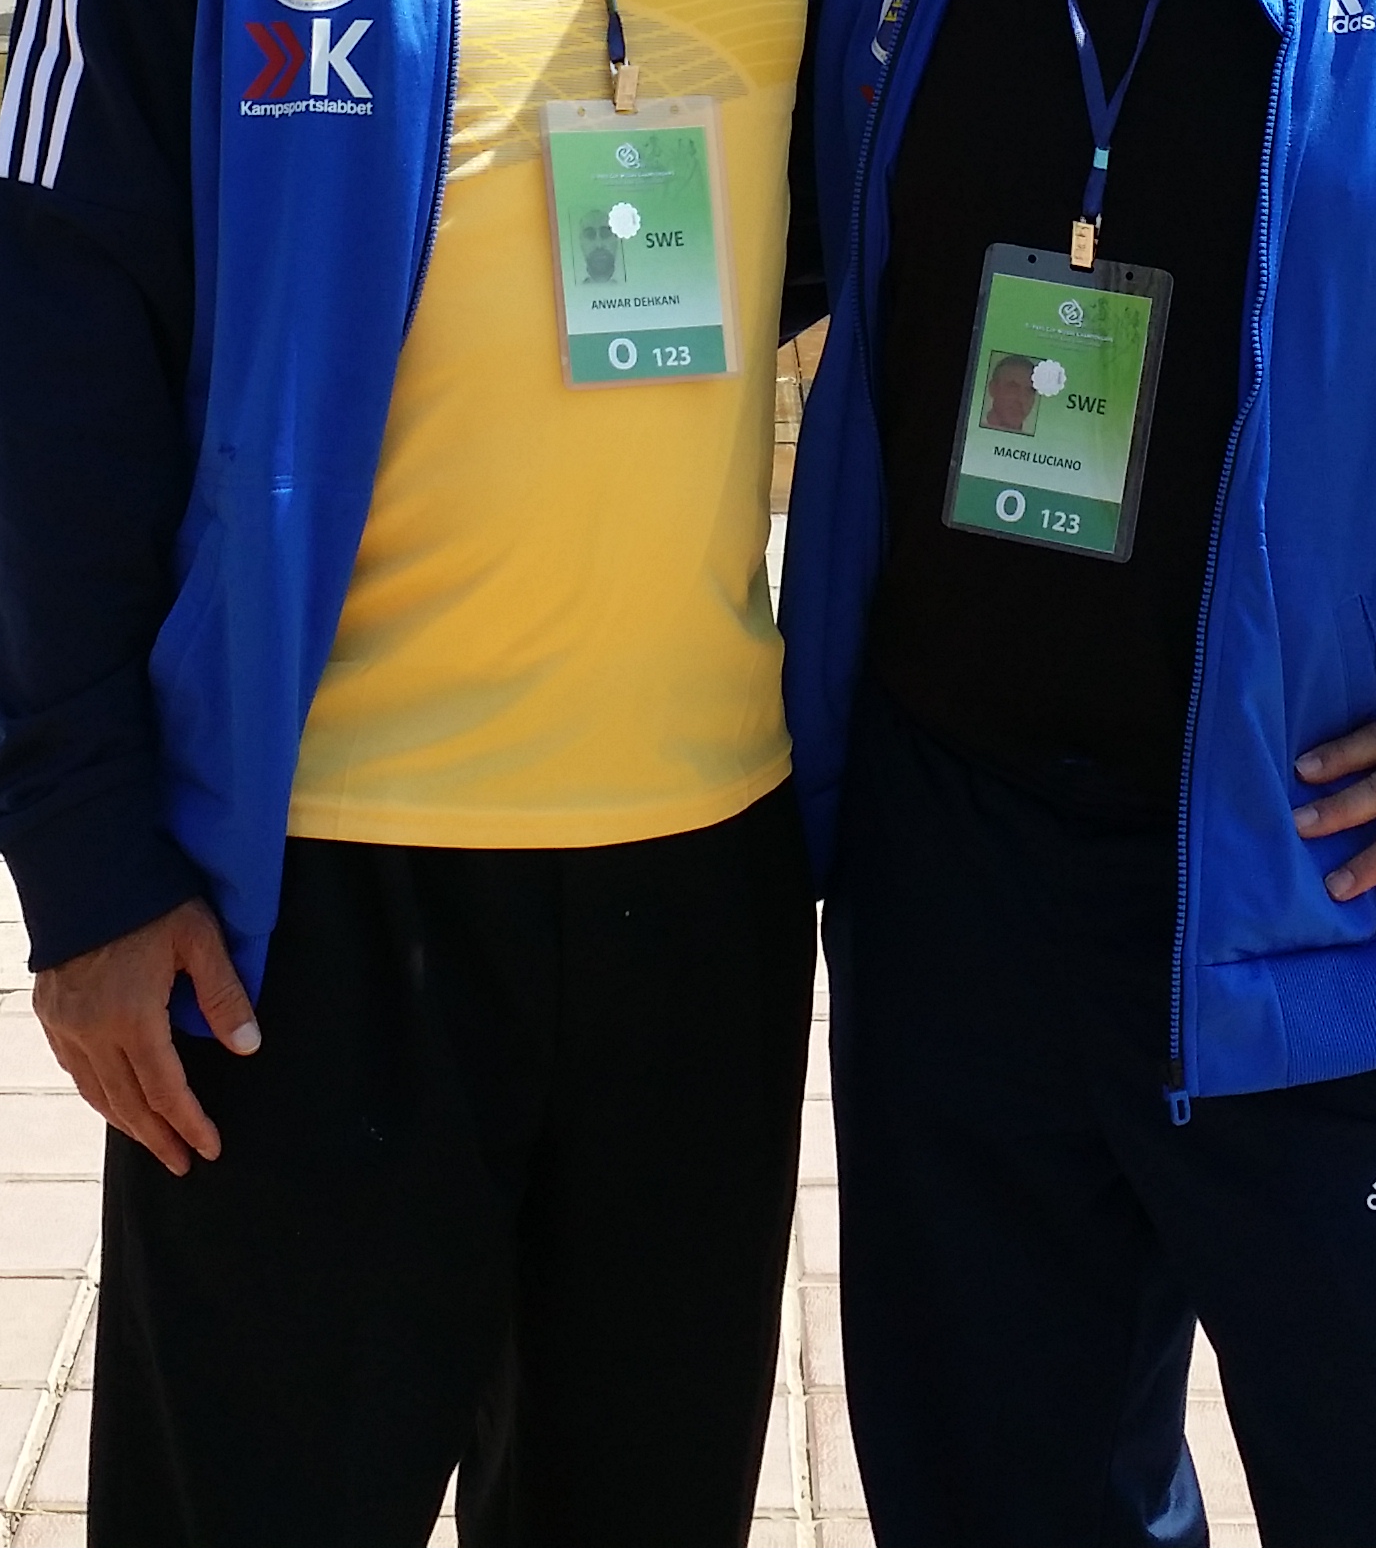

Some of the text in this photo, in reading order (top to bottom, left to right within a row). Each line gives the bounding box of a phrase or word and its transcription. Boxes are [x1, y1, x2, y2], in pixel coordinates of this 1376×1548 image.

[310, 18, 374, 98] K
[240, 99, 374, 118] Kampsportslabbet
[645, 231, 685, 248] SWE
[591, 295, 680, 310] ANWAR DEHKANI
[652, 346, 692, 367] 123
[1066, 393, 1107, 415] SWE
[994, 446, 1082, 471] MACRI LUCIANO
[1040, 509, 1081, 534] 123
